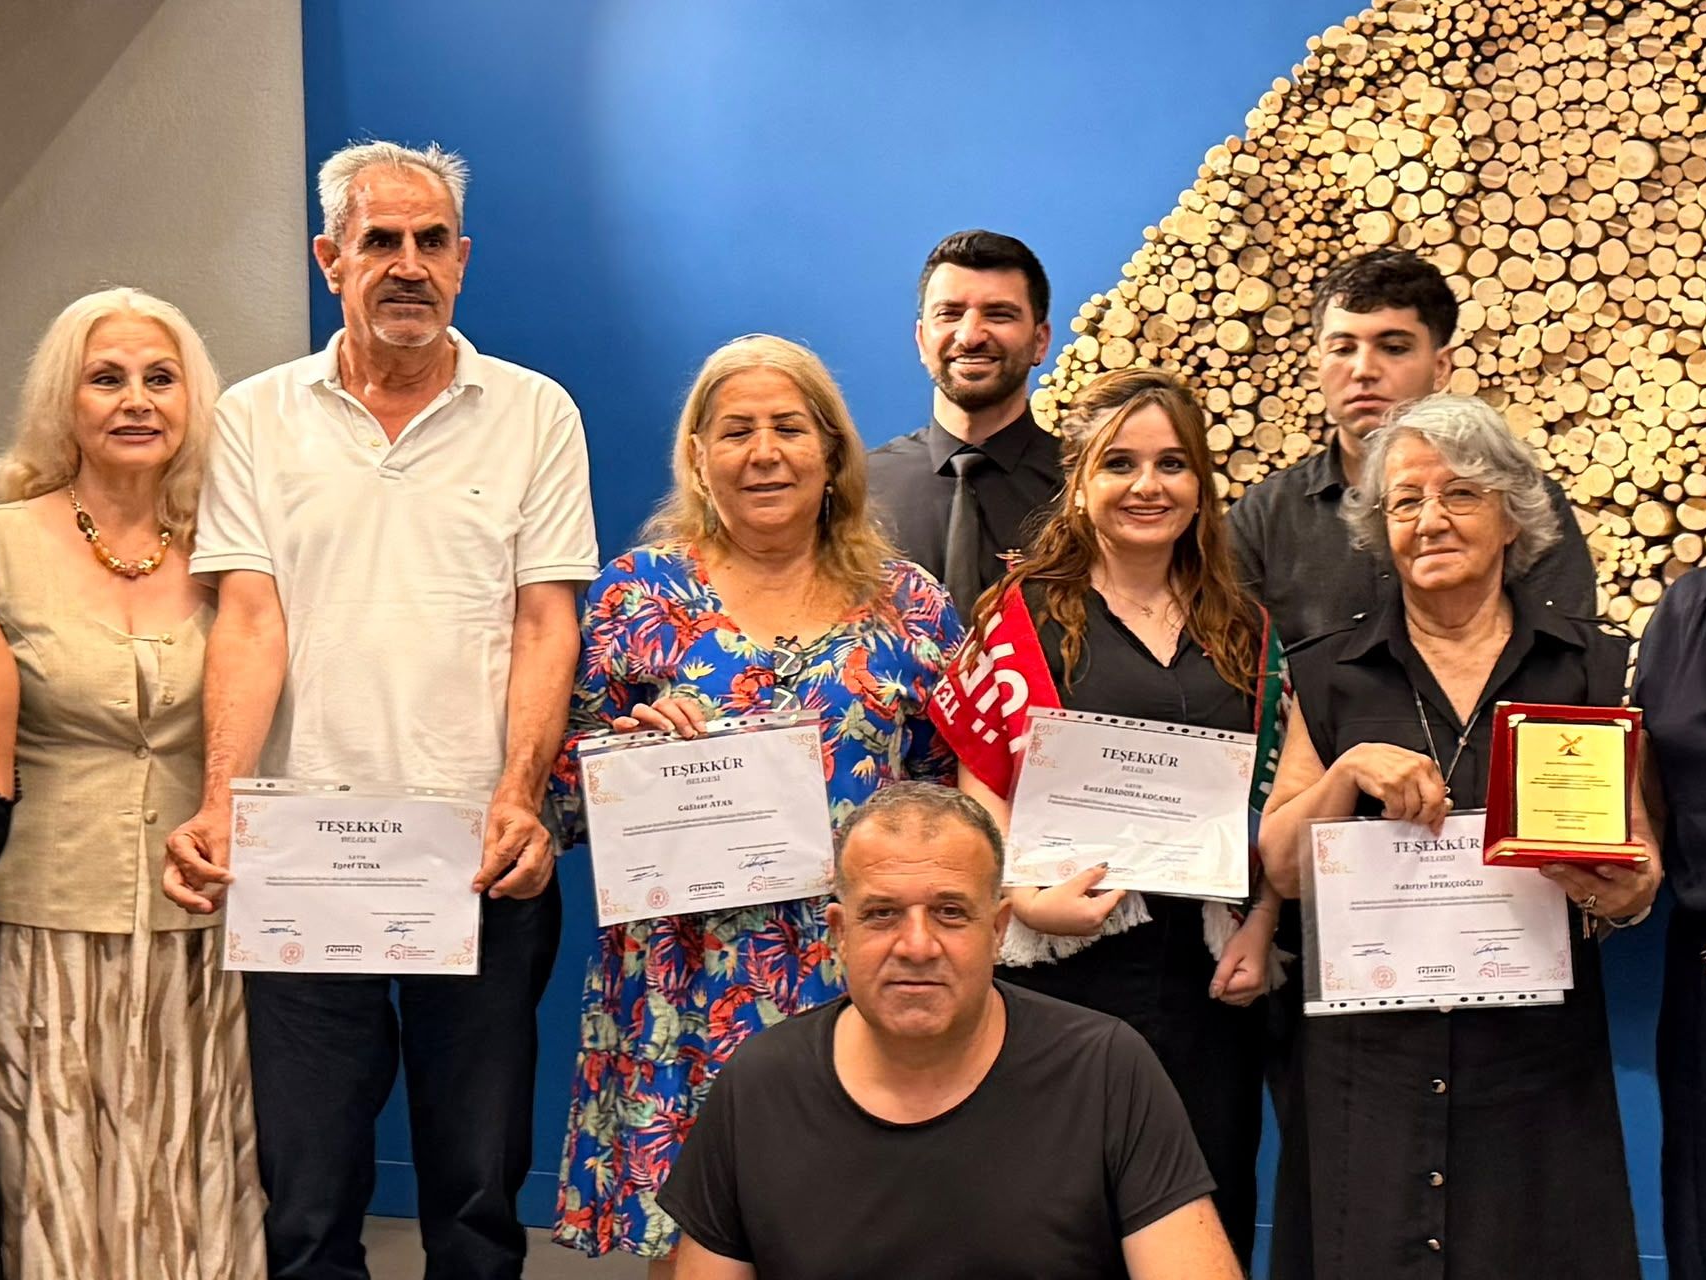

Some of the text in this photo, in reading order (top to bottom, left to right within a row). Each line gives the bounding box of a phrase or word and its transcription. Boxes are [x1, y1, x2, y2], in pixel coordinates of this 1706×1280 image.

[1101, 747, 1178, 767] TEŞEKKÜR
[660, 757, 744, 778] TEŞEKKÜR
[316, 819, 403, 834] TEŞEKKÜR
[1393, 836, 1481, 854] TEŞEKKÜR
